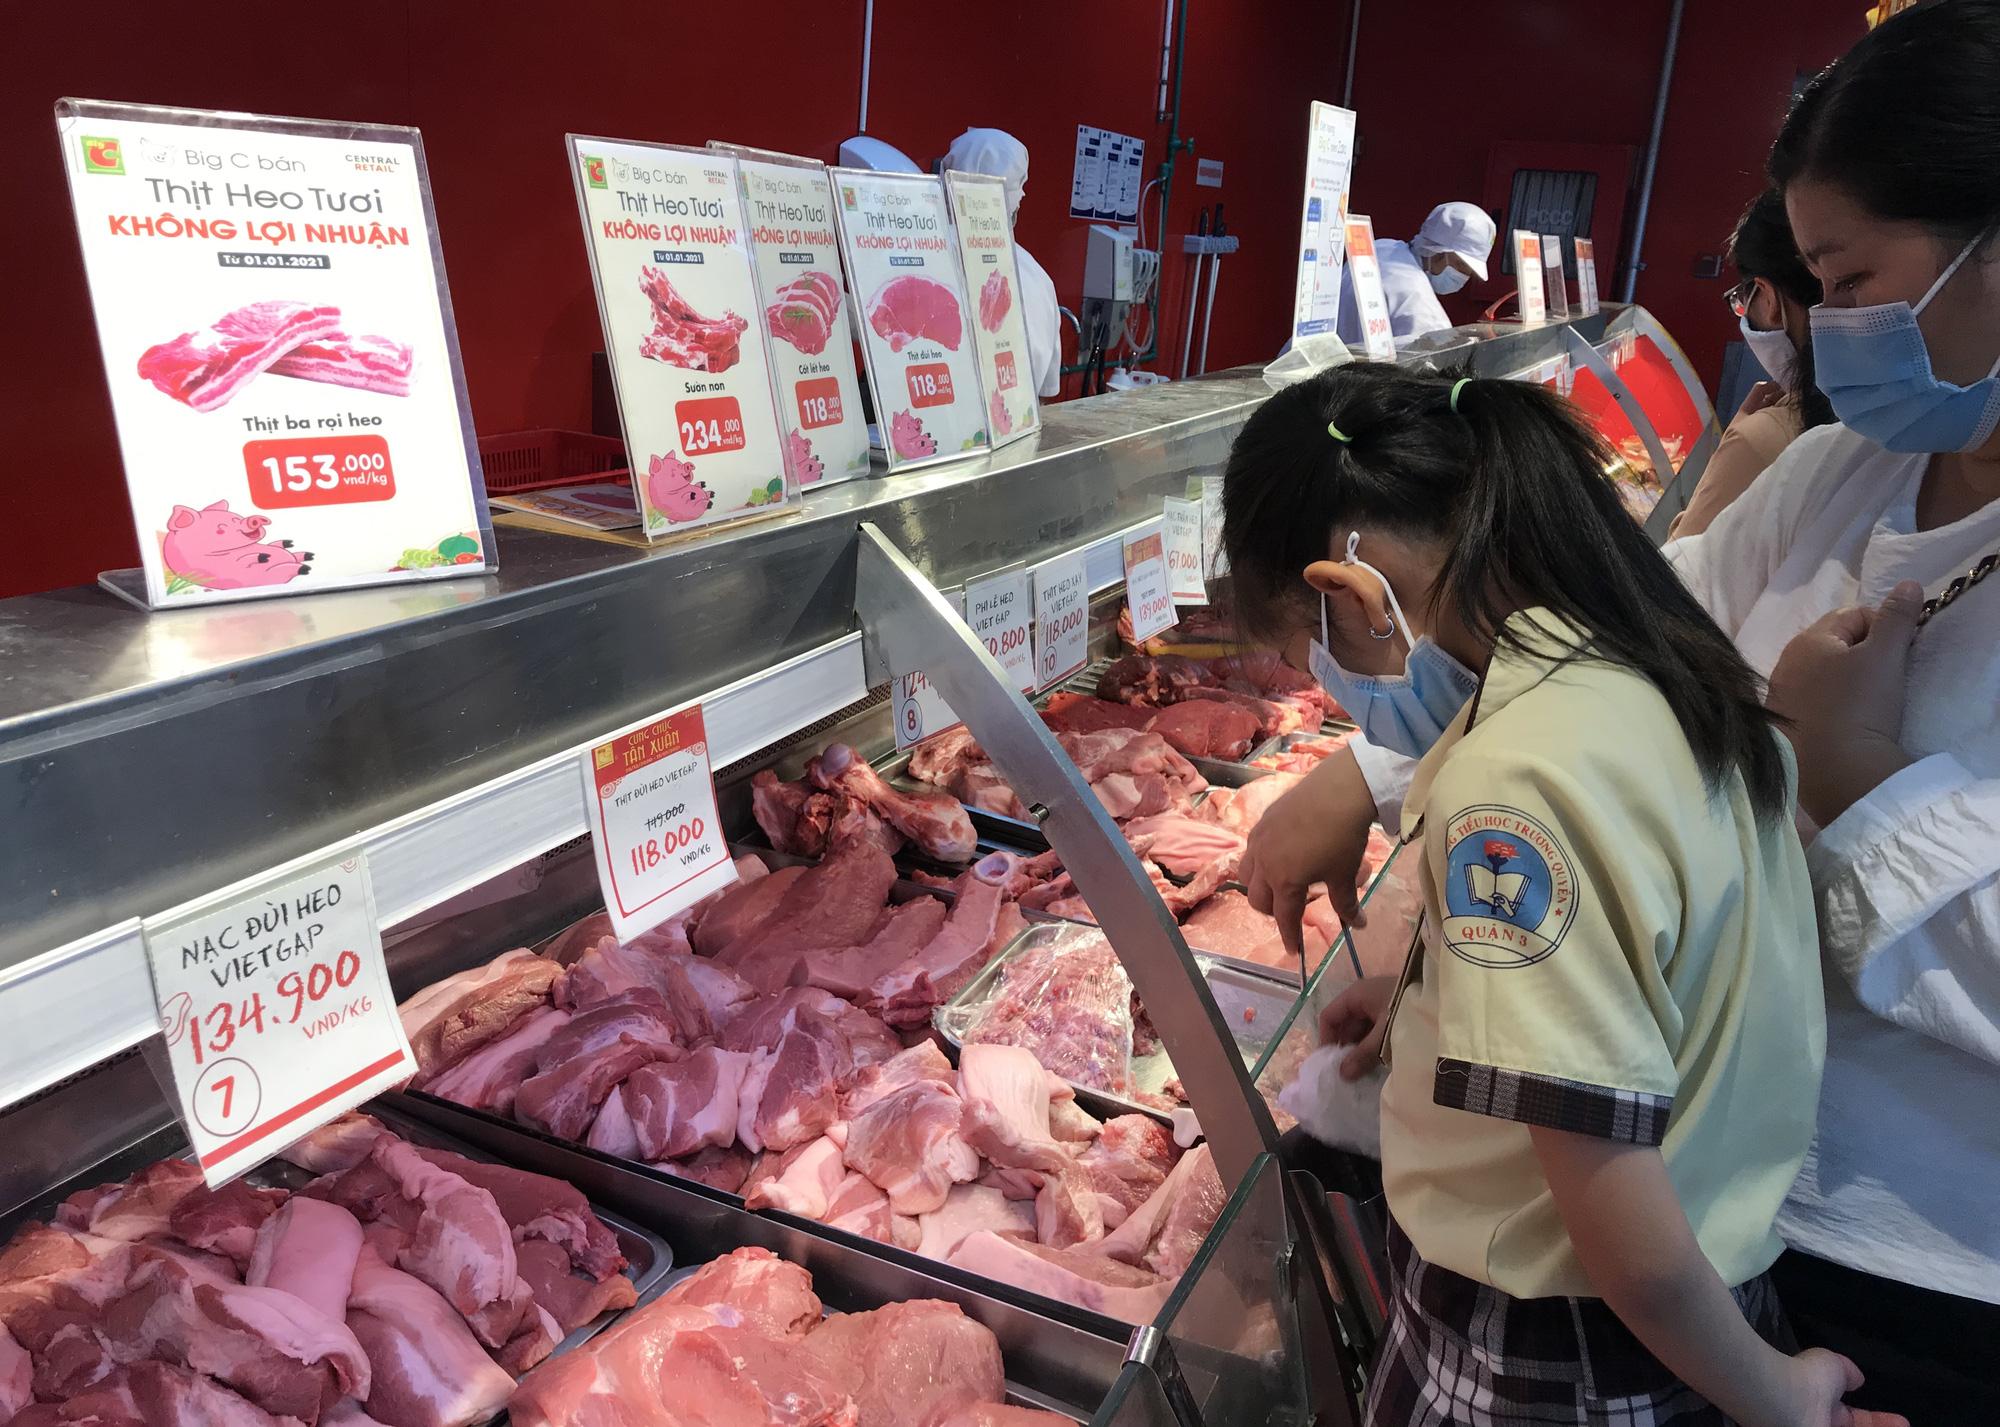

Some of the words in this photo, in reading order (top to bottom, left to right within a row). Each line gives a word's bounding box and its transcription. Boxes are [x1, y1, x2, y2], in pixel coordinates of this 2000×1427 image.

[185, 149, 222, 170] Big
[231, 153, 249, 168] C
[258, 154, 306, 172] bán
[345, 154, 400, 165] CENTRAL
[355, 163, 395, 173] RETAIL
[632, 166, 650, 185] Big
[653, 170, 663, 182] C
[665, 170, 687, 184] bán
[145, 178, 213, 210] Thịt
[225, 182, 304, 210] Heo
[308, 187, 383, 213] Tươi
[616, 191, 648, 217] Thịt
[653, 193, 688, 216] Heo
[689, 197, 724, 218] Tươi
[755, 201, 776, 224] Thịt
[778, 203, 803, 220] Heo
[802, 204, 826, 222] Tươi
[864, 211, 885, 231] Thịt
[888, 213, 912, 230] Heo
[912, 214, 937, 230] Tươi
[108, 212, 237, 240] KHÔNG
[246, 221, 296, 246] LỢI
[304, 221, 409, 249] NHUẬN
[603, 218, 661, 241] KHÔNG
[664, 224, 687, 245] LỢI
[690, 225, 737, 248] NHUẬN
[752, 224, 784, 244] HÔNG
[786, 229, 802, 248] LỢI
[803, 229, 835, 249] NHUẬN
[856, 233, 894, 249] KHÔNG
[896, 236, 912, 252] LỢI
[914, 236, 947, 253] NHUẬN
[244, 255, 324, 267] 01.01.2021
[665, 253, 701, 263] 01.01.2021
[709, 382, 725, 391] non
[243, 416, 280, 434] Thịt
[285, 415, 311, 429] ba
[317, 413, 343, 431] rọi
[348, 412, 382, 427] heo
[343, 471, 388, 486] vnd/kg
[1058, 580, 1071, 594] HEO
[975, 600, 989, 616] PHI
[1000, 591, 1014, 606] HEO
[996, 609, 1010, 625] GAP
[1046, 607, 1083, 647] 118.000
[1044, 653, 1056, 675] 10
[907, 709, 917, 731] 8
[623, 744, 645, 766] TÂN
[649, 777, 665, 793] HEO
[664, 761, 698, 784] VIETGAP
[1456, 815, 1482, 837] TIỂU
[1484, 816, 1511, 829] HỌC
[631, 817, 704, 877] 118.000
[680, 843, 711, 866] VND/KG
[182, 926, 240, 970] NẠC
[246, 902, 288, 942] ĐÙI
[296, 883, 341, 921] HEO
[1461, 923, 1515, 942] QUẬN
[1519, 935, 1528, 947] 3
[211, 923, 325, 988] VIETGAP
[190, 949, 361, 1065] 134.900
[302, 995, 373, 1040] VND/KG
[211, 1076, 235, 1119] 7
